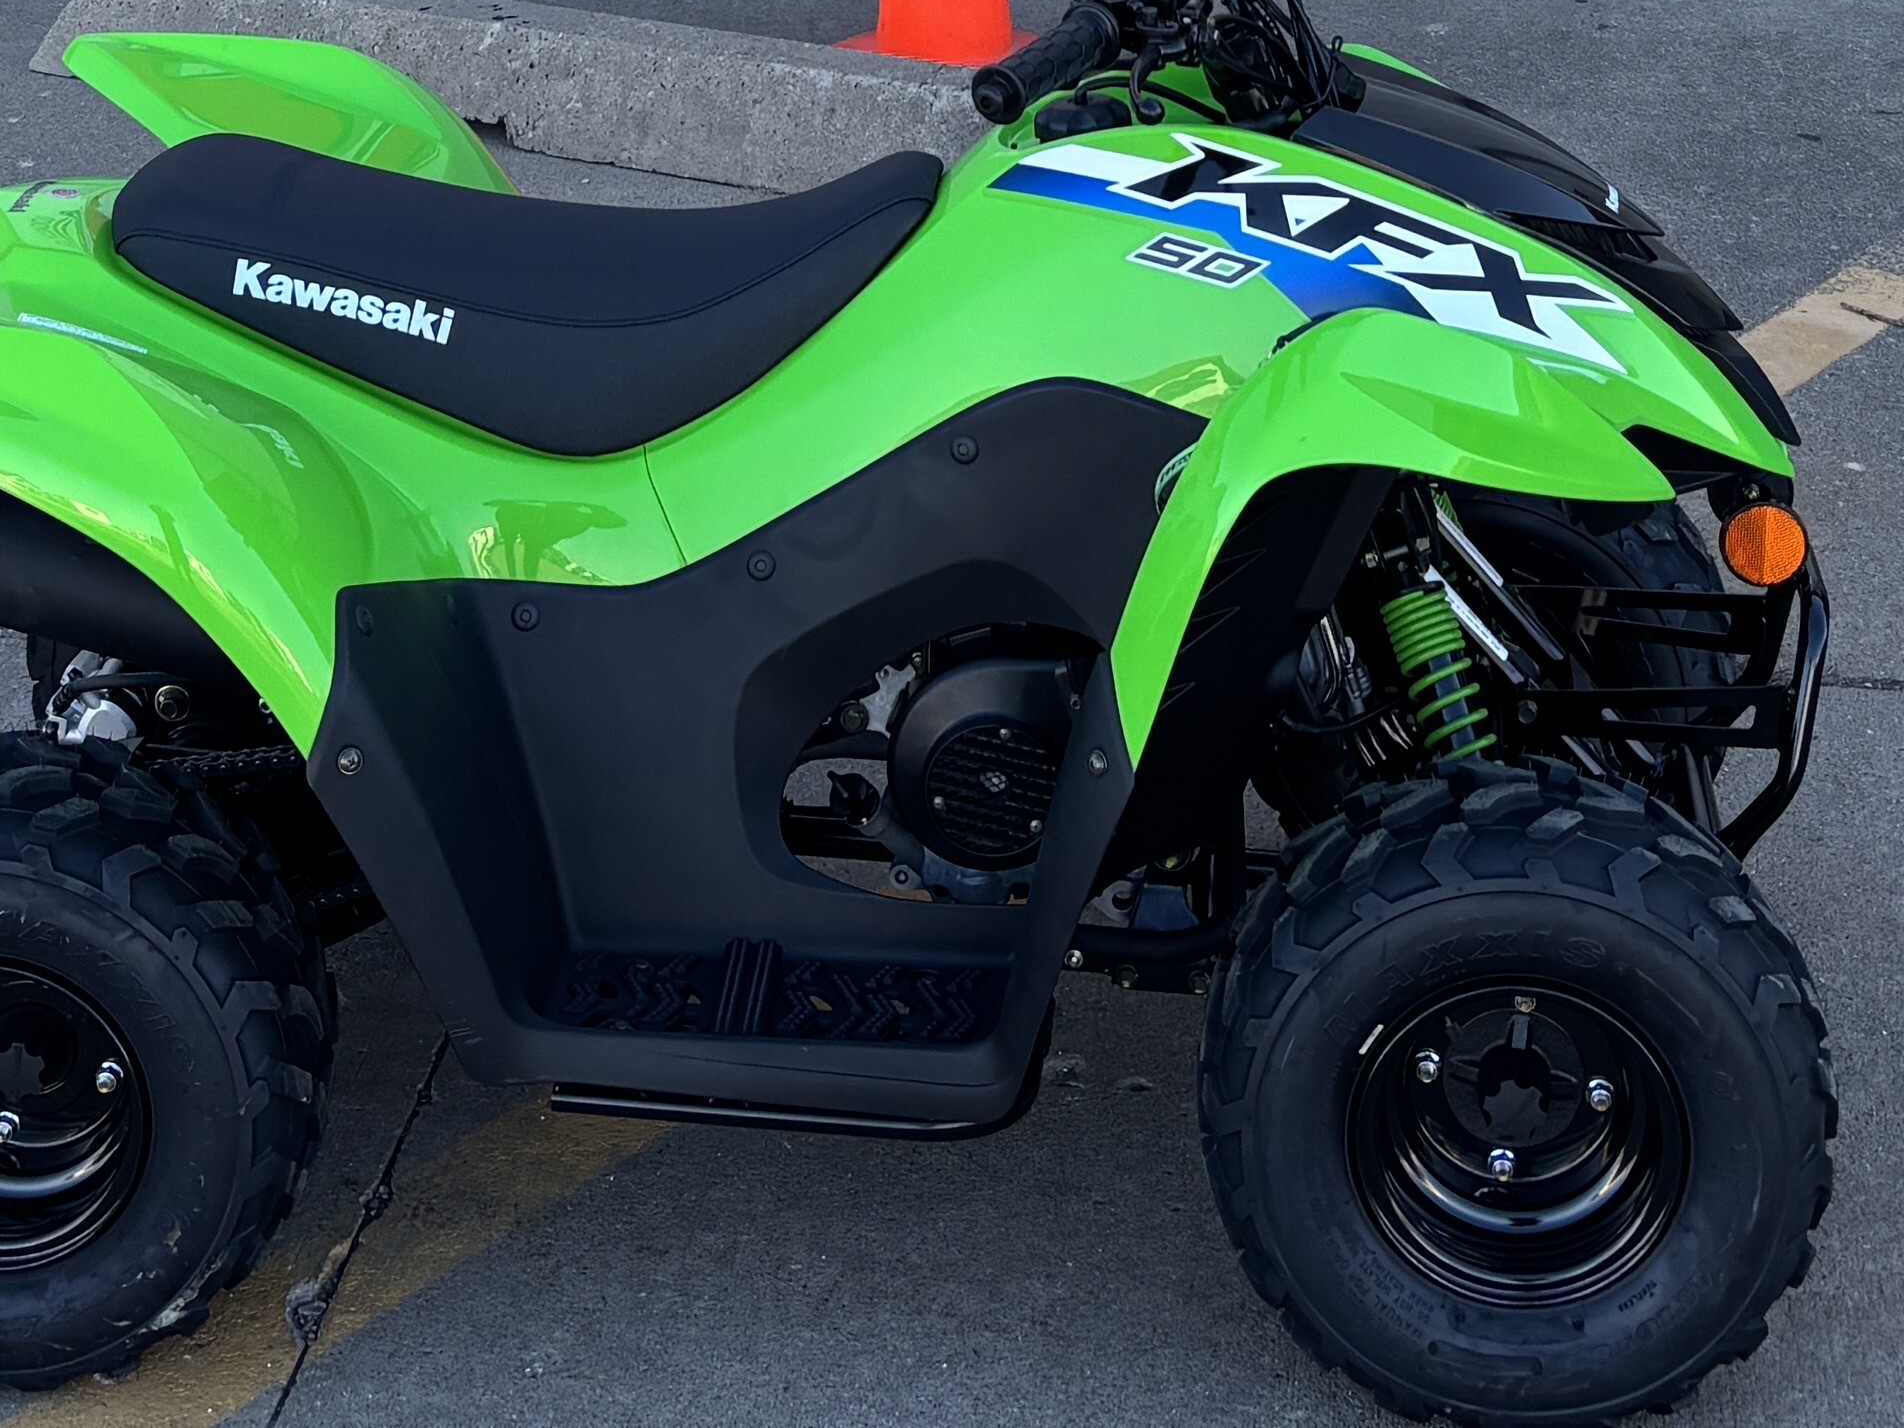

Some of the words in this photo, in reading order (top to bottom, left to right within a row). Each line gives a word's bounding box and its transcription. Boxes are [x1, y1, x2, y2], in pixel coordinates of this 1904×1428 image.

[1112, 134, 1631, 346] KFX
[1128, 234, 1270, 287] 50
[232, 258, 455, 345] Kawasaki
